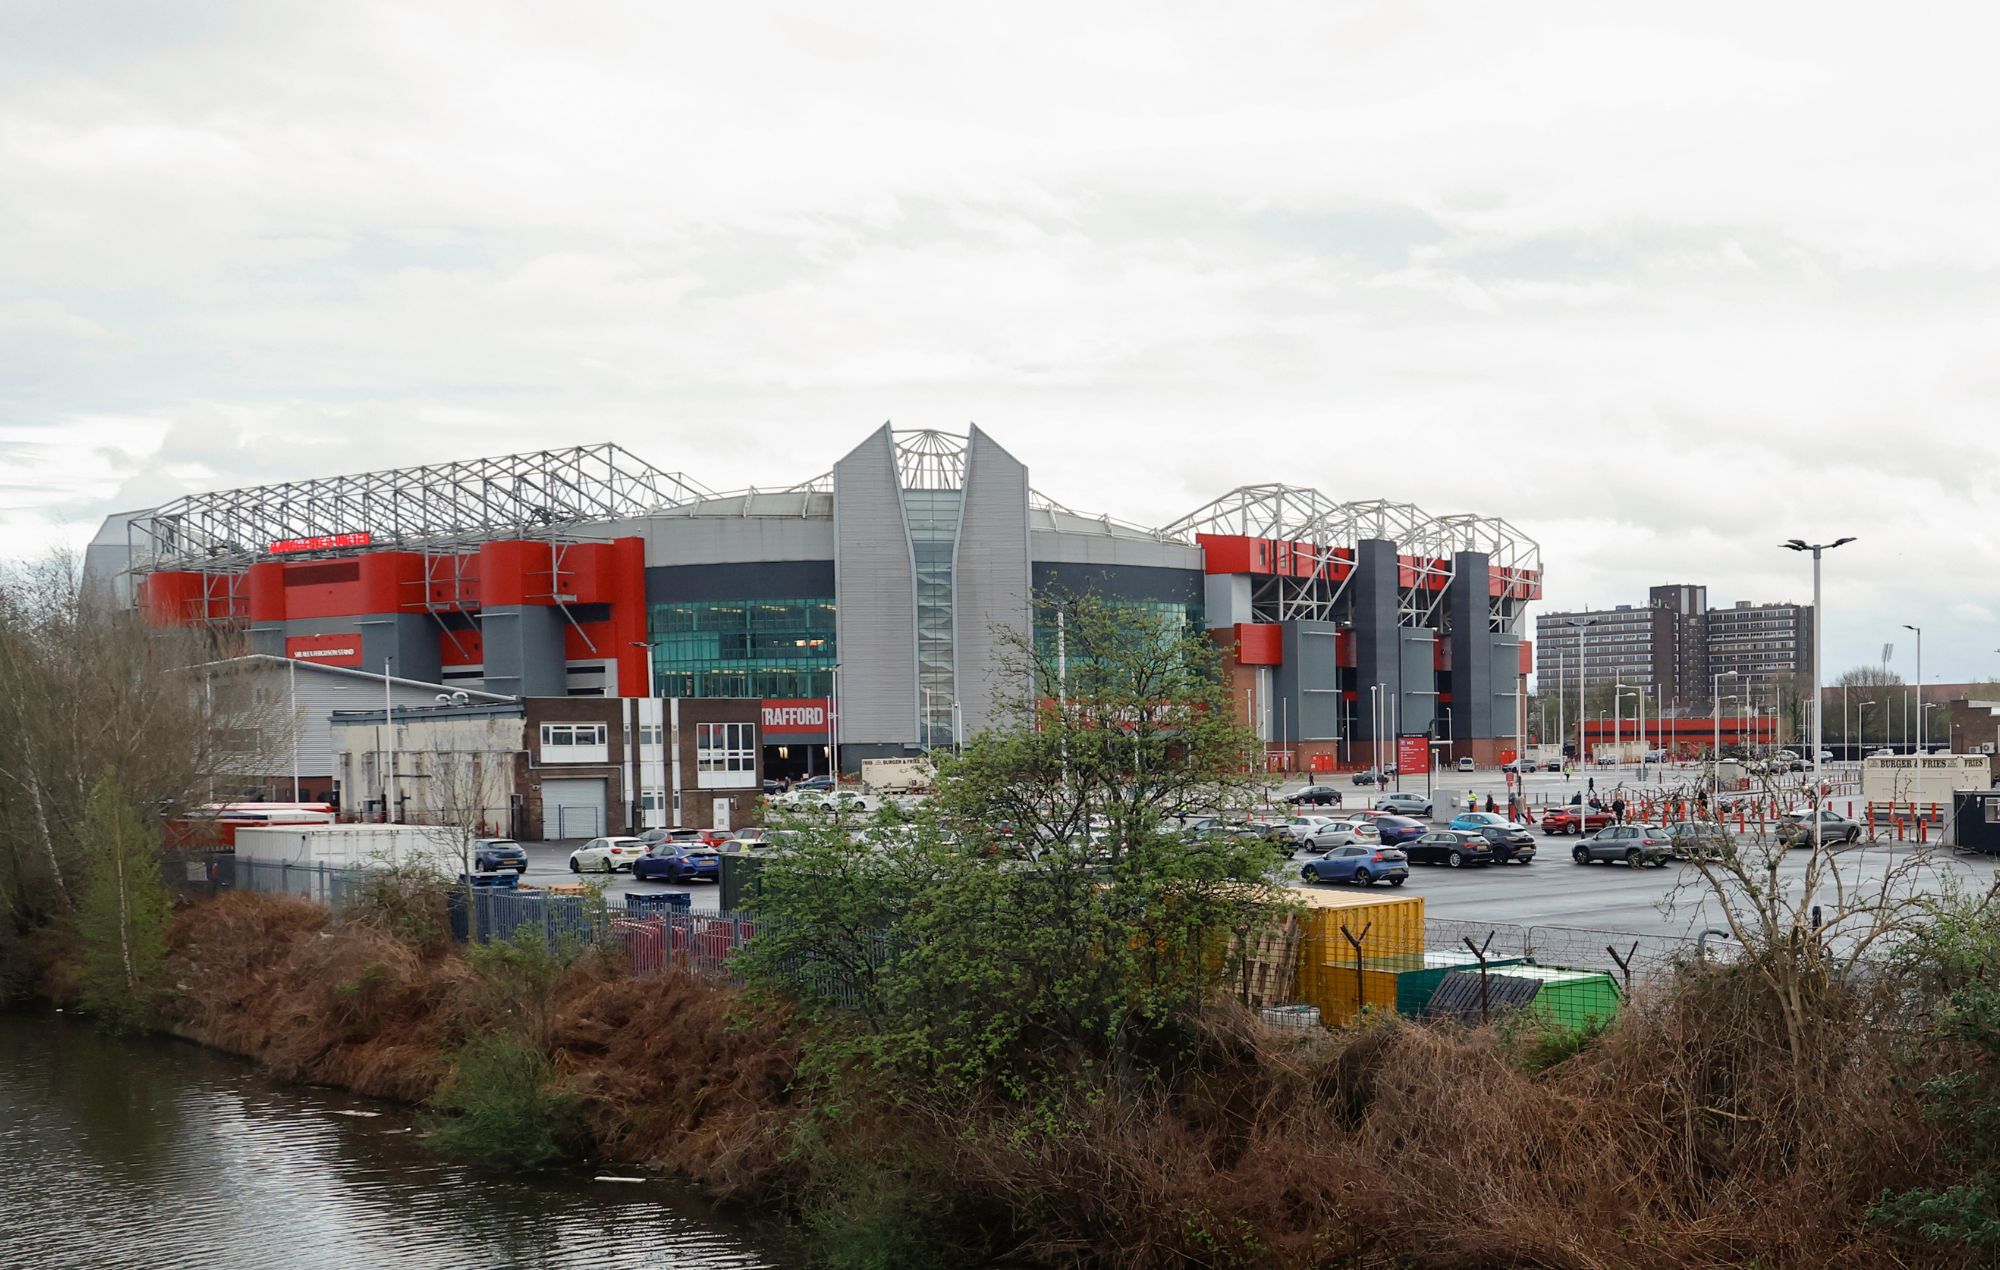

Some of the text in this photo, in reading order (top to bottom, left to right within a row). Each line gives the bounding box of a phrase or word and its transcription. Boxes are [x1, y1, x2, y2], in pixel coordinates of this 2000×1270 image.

[1880, 760, 1912, 768] BURGER
[1922, 760, 1946, 768] FRIES
[1964, 759, 1983, 767] FRIES
